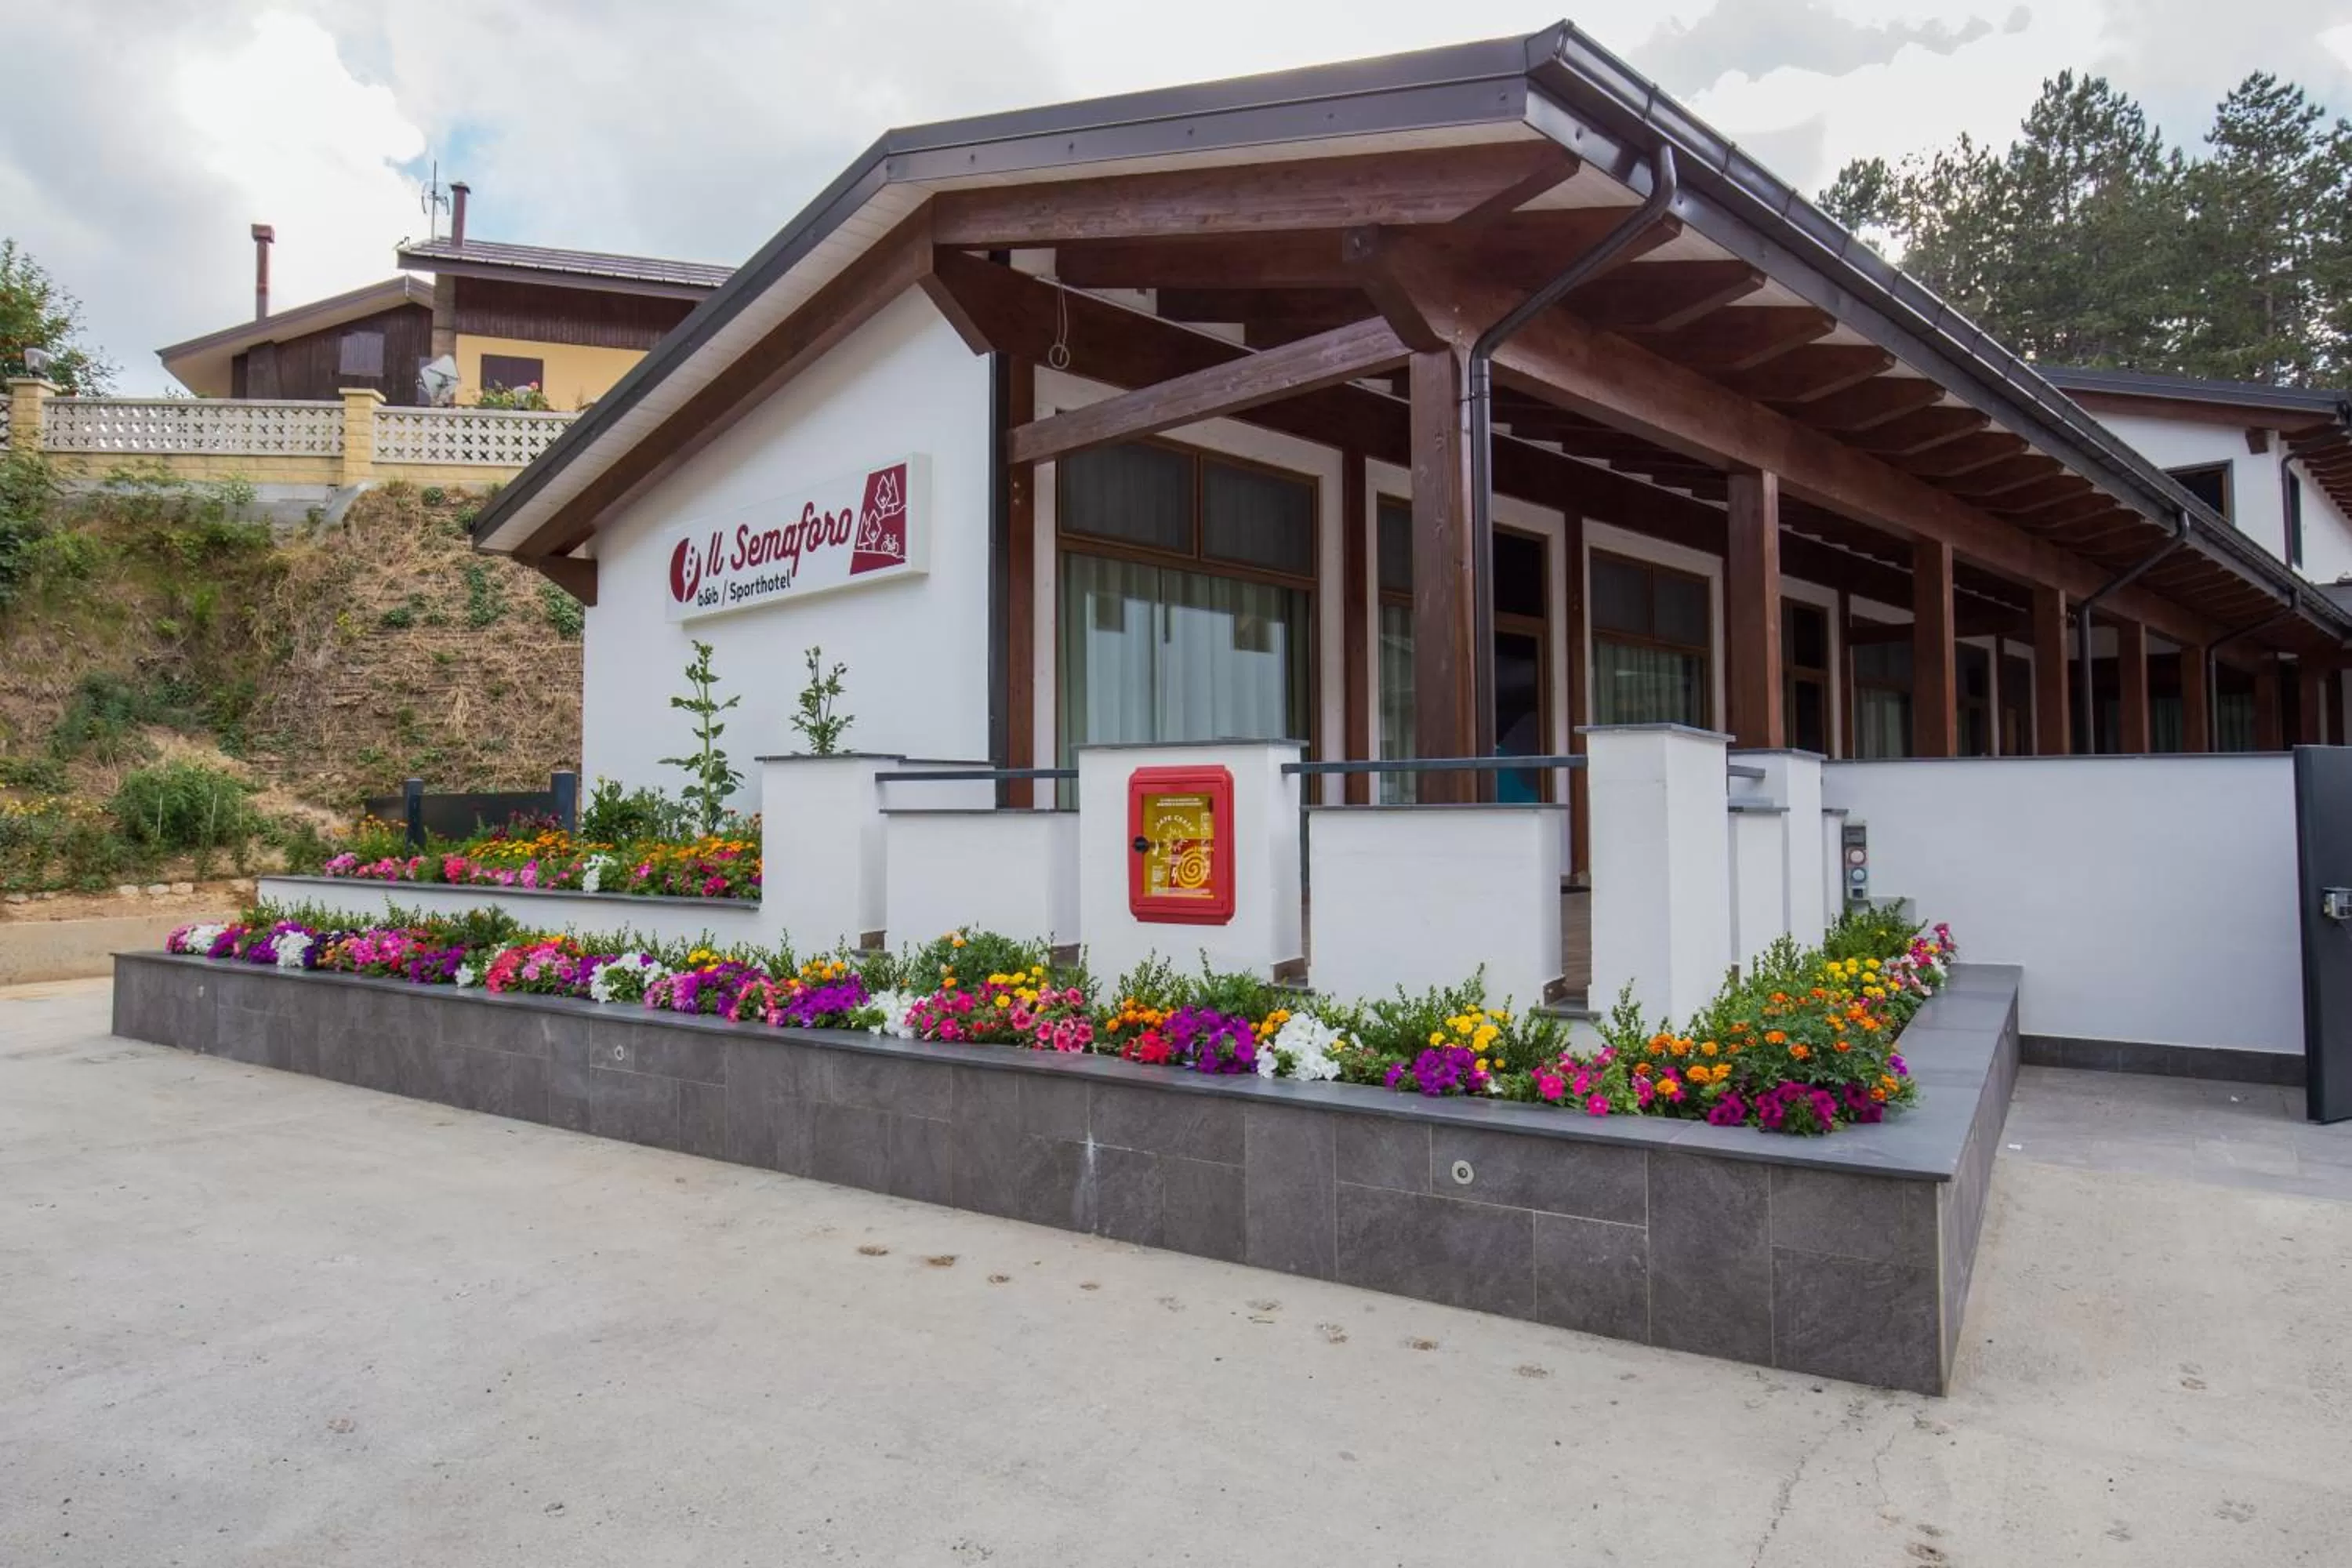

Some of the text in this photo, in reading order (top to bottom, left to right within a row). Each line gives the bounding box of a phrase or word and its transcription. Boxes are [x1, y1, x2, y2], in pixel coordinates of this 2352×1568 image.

[706, 501, 853, 577] Il Semaforo
[698, 586, 719, 607] b&b
[730, 569, 791, 602] Sporthotel
